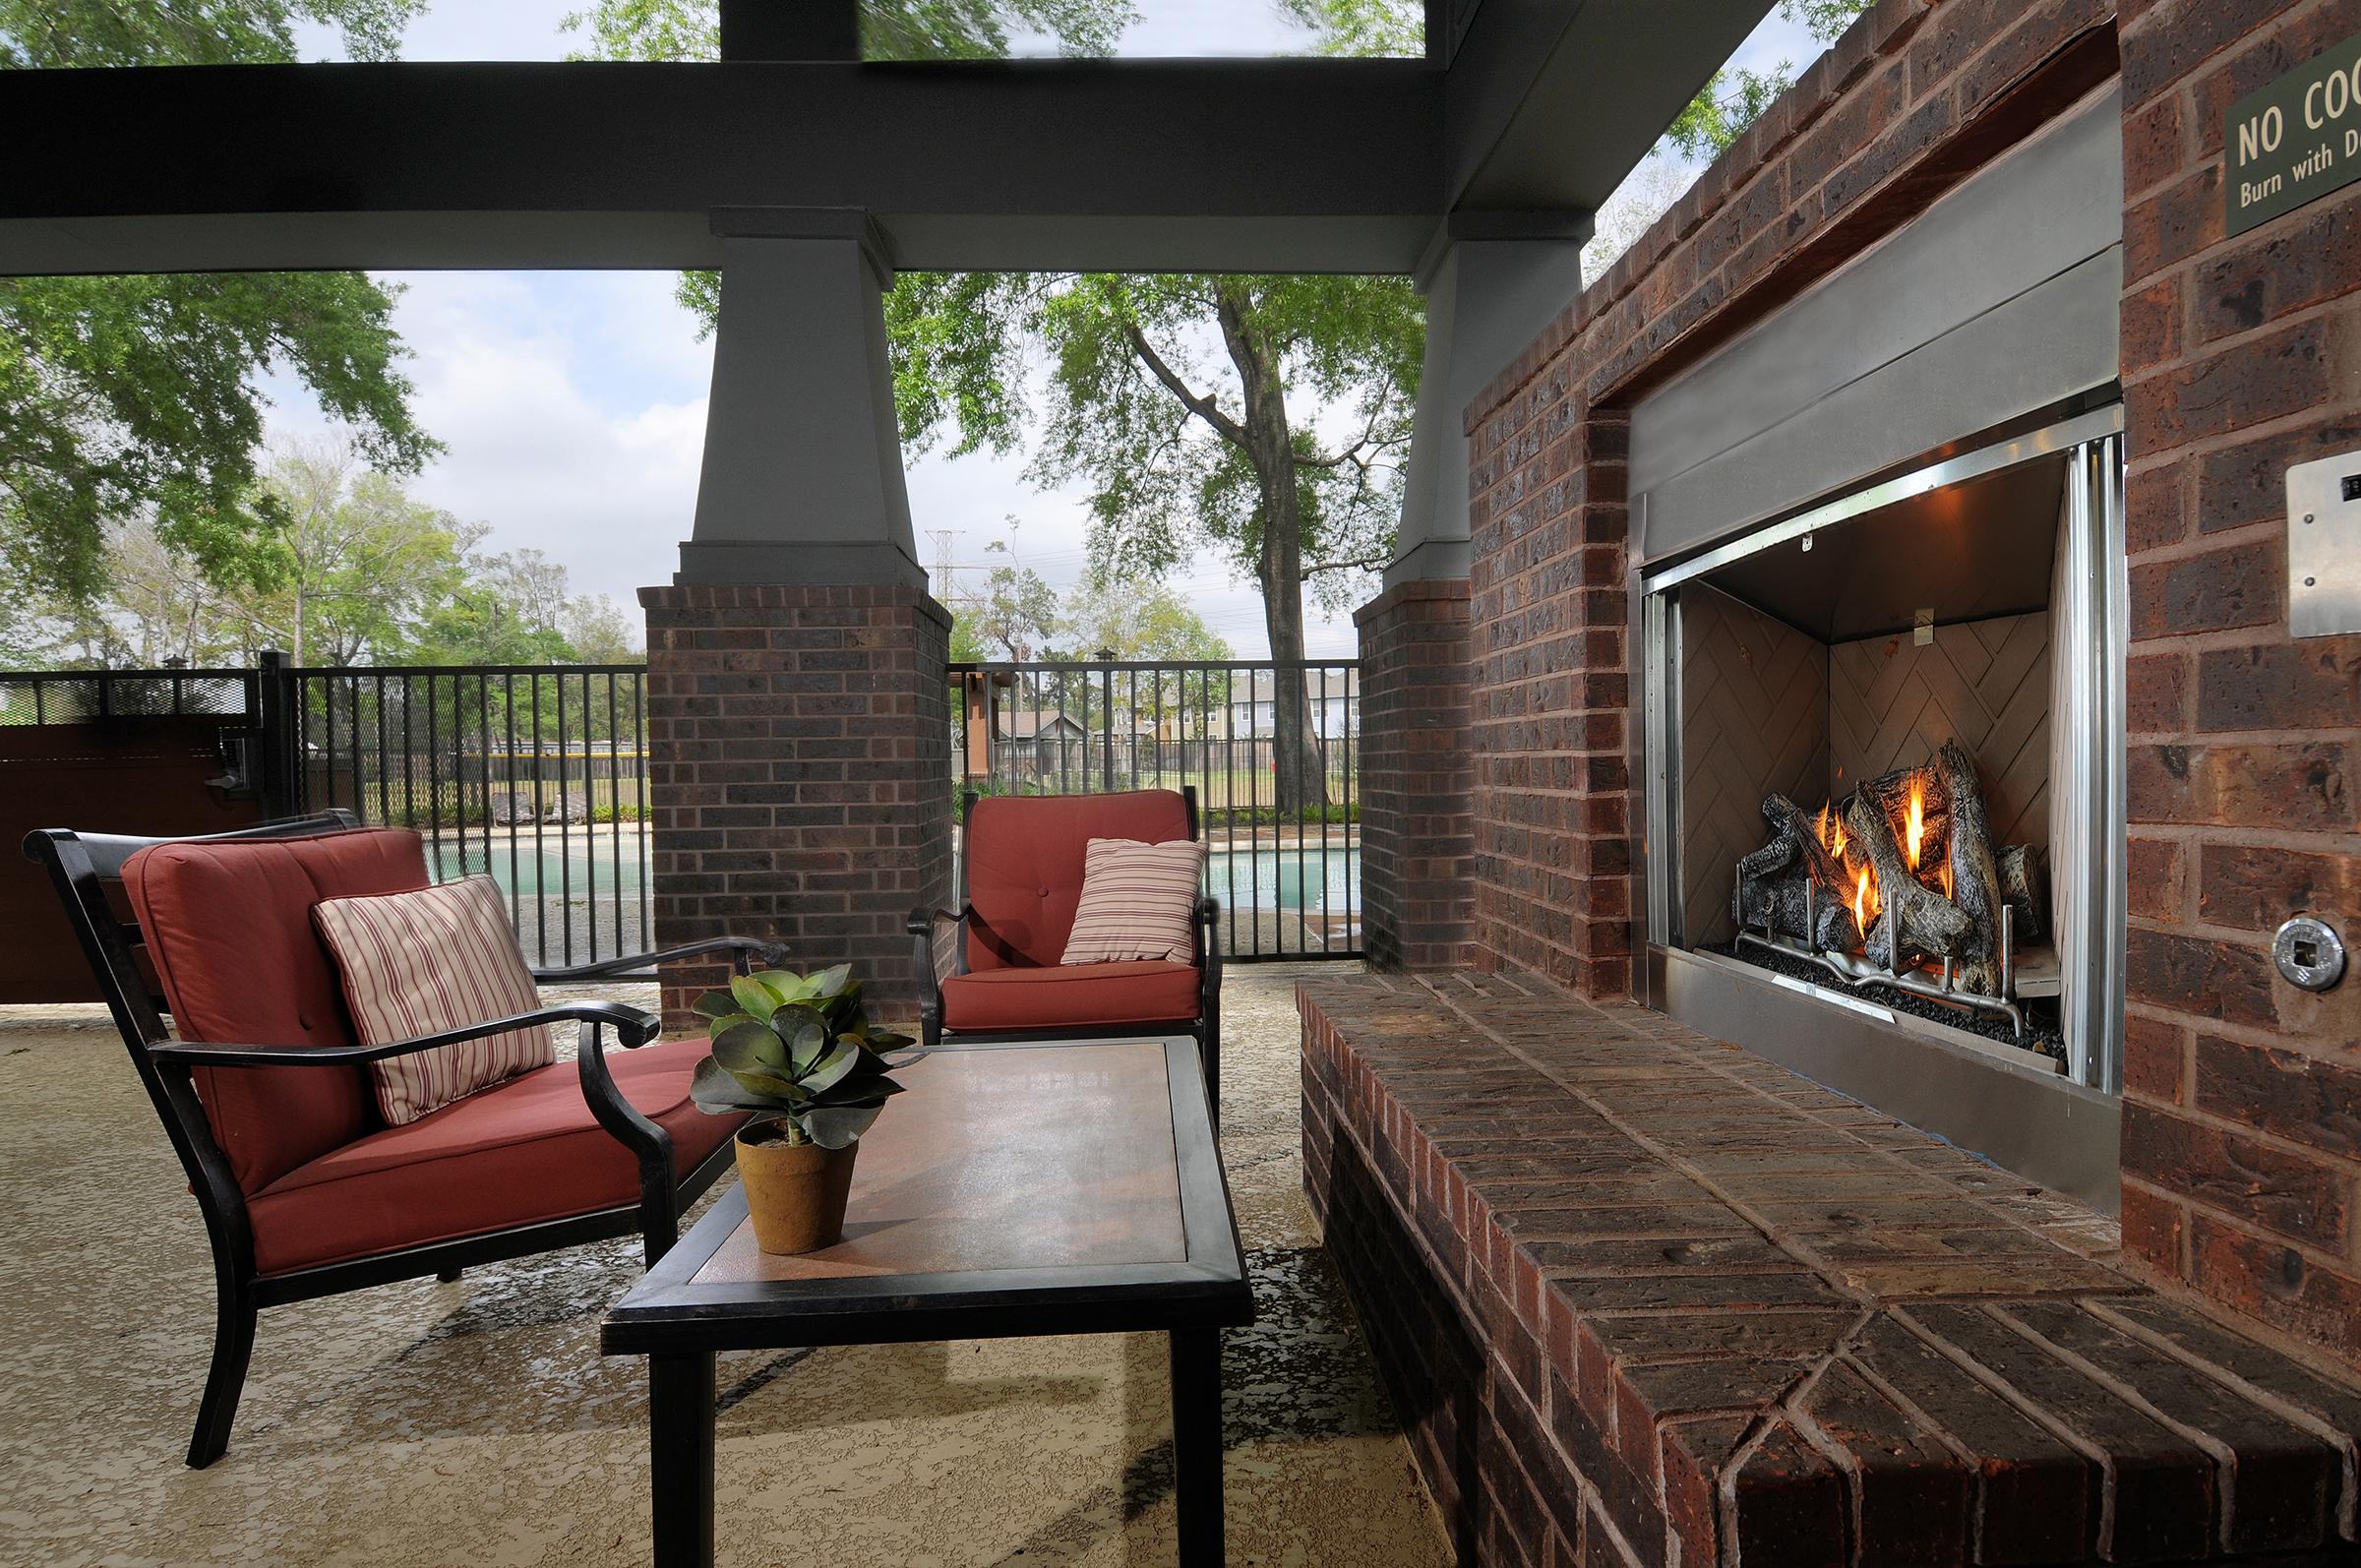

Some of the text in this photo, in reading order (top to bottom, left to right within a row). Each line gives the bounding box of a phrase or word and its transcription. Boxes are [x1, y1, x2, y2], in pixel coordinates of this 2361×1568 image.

[2239, 106, 2282, 167] NO
[2240, 129, 2361, 209] Burn with D
